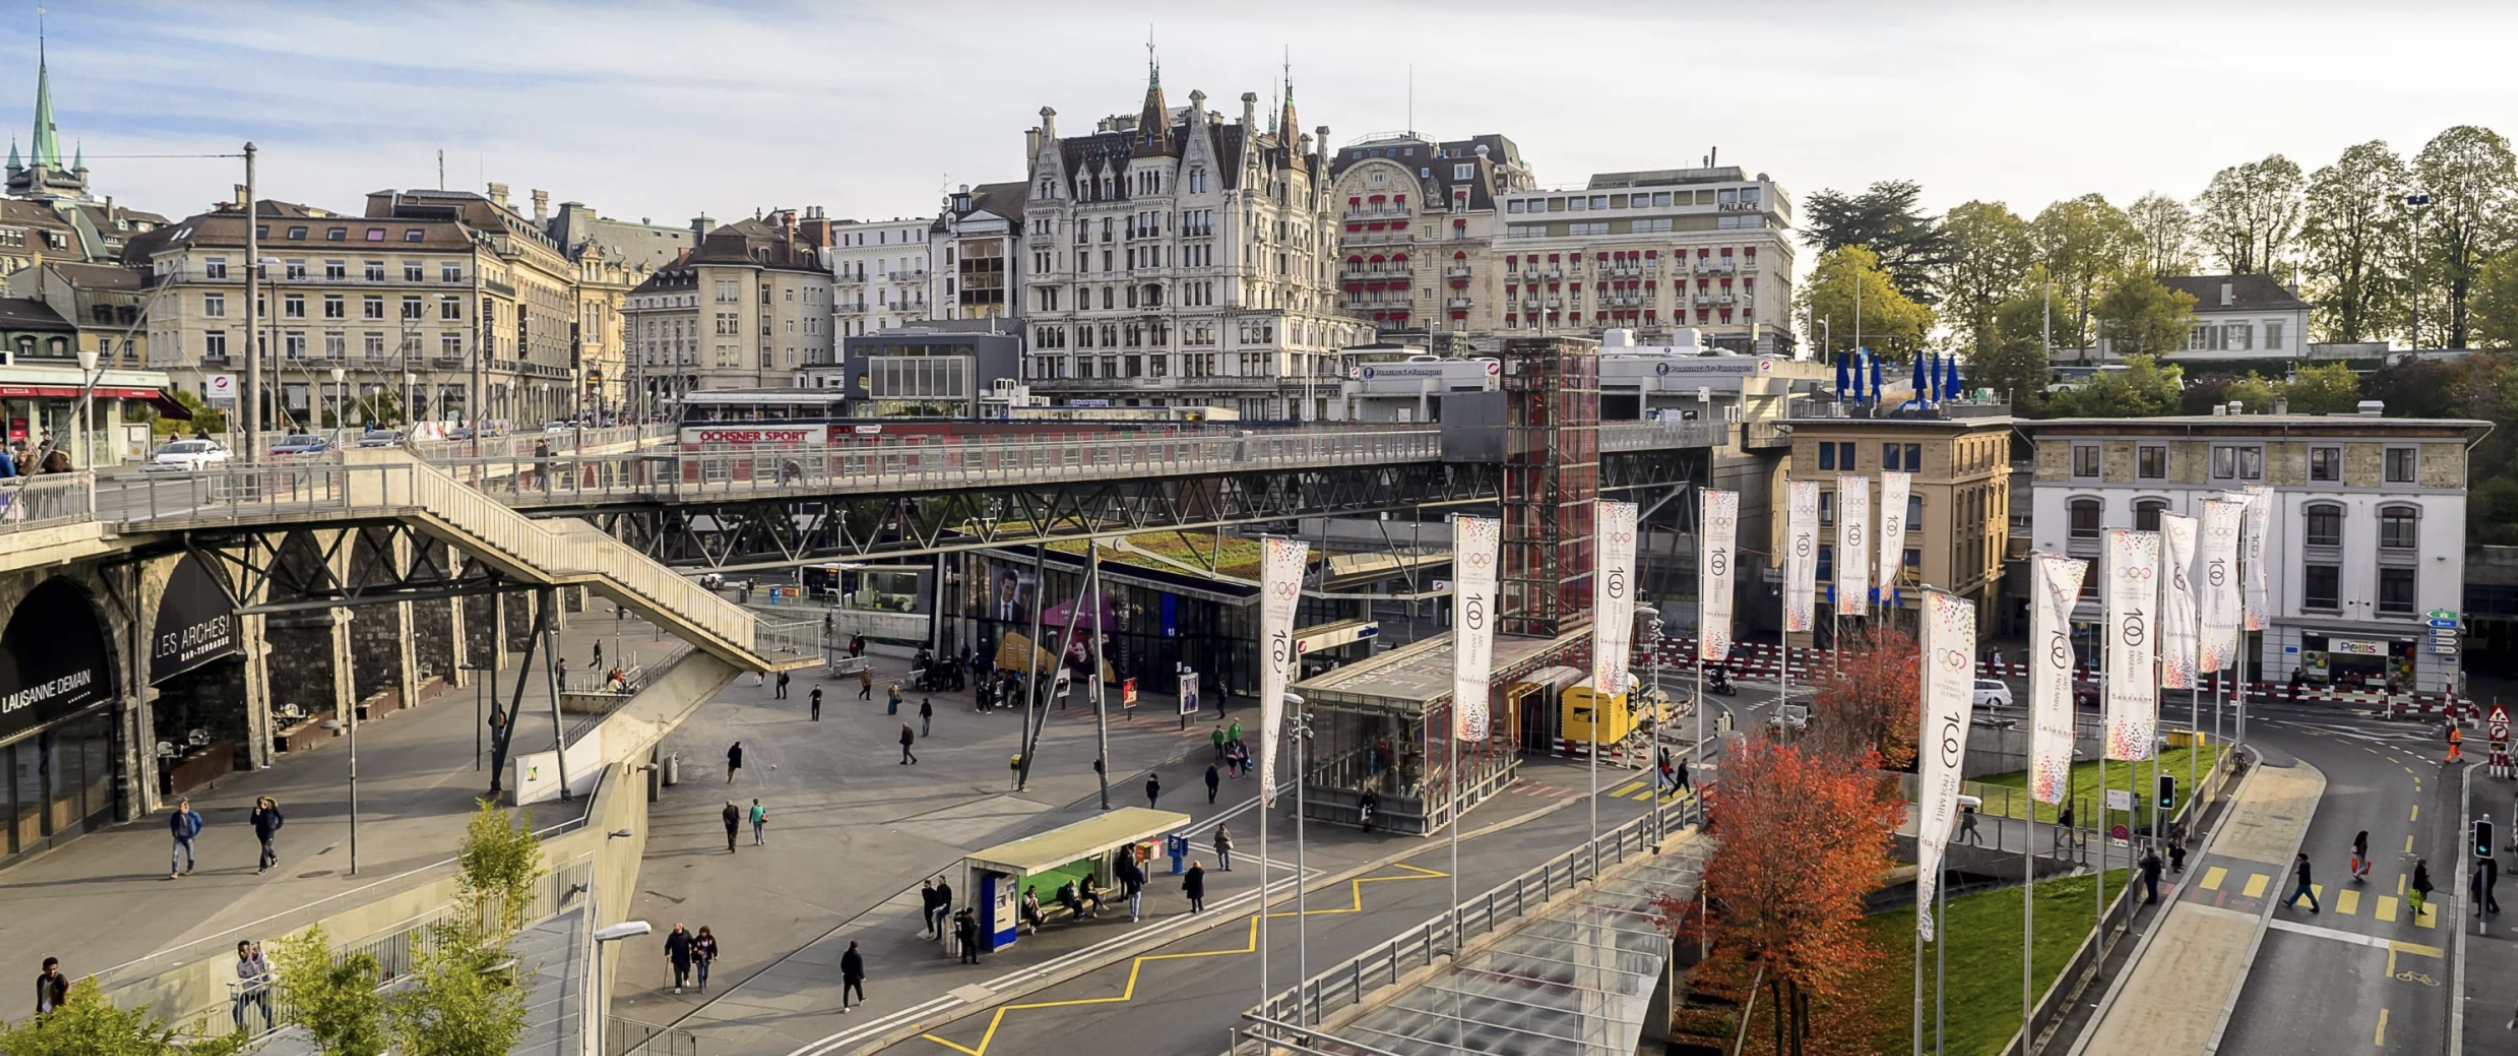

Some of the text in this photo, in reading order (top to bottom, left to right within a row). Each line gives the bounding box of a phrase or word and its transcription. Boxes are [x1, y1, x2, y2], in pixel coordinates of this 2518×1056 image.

[1719, 202, 1758, 211] PALACE
[700, 431, 807, 442] OCHSNER SPORT
[1848, 522, 1862, 547] 100
[1887, 514, 1899, 537] 100
[1796, 531, 1811, 558] 100
[1711, 547, 1726, 576] 100
[2209, 557, 2226, 587] 100
[1607, 566, 1625, 599] 100
[1466, 592, 1484, 630] 100
[155, 615, 230, 658] LES ARCHES!
[2123, 608, 2143, 647] 100
[181, 635, 230, 661] BAR-TERRASSE
[2340, 642, 2376, 654] Petits
[2, 680, 56, 714] LAUSANNE
[57, 669, 91, 693] DEMAIN
[1942, 711, 1960, 769] 100
[1935, 774, 1949, 823] ENSEMBLE
